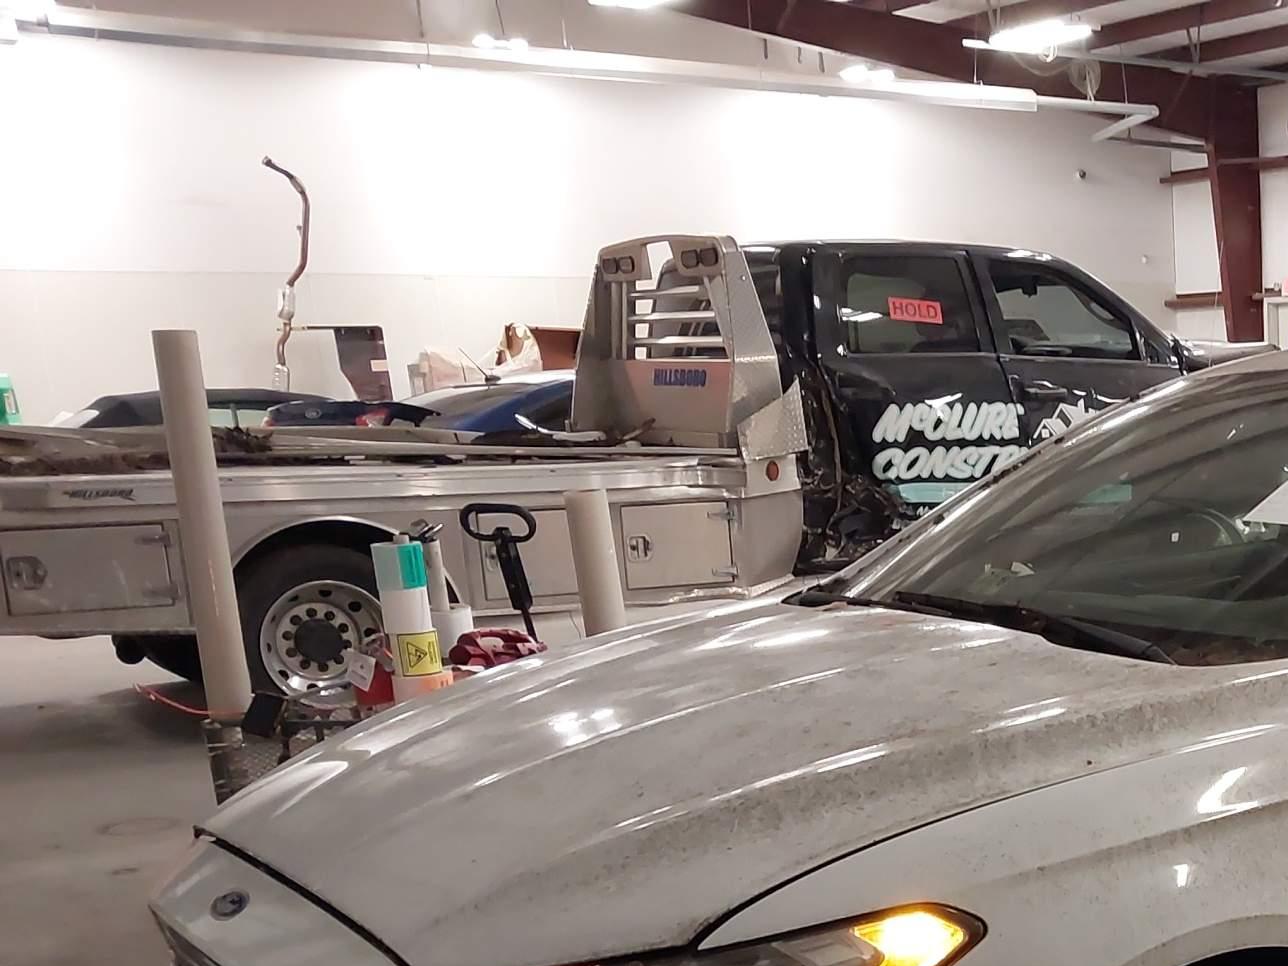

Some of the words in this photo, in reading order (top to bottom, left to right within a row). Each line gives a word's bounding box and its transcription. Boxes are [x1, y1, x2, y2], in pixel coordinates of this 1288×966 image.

[892, 301, 938, 319] HOLD
[653, 368, 707, 387] HILLSBORO
[872, 445, 1029, 479] CONSTR
